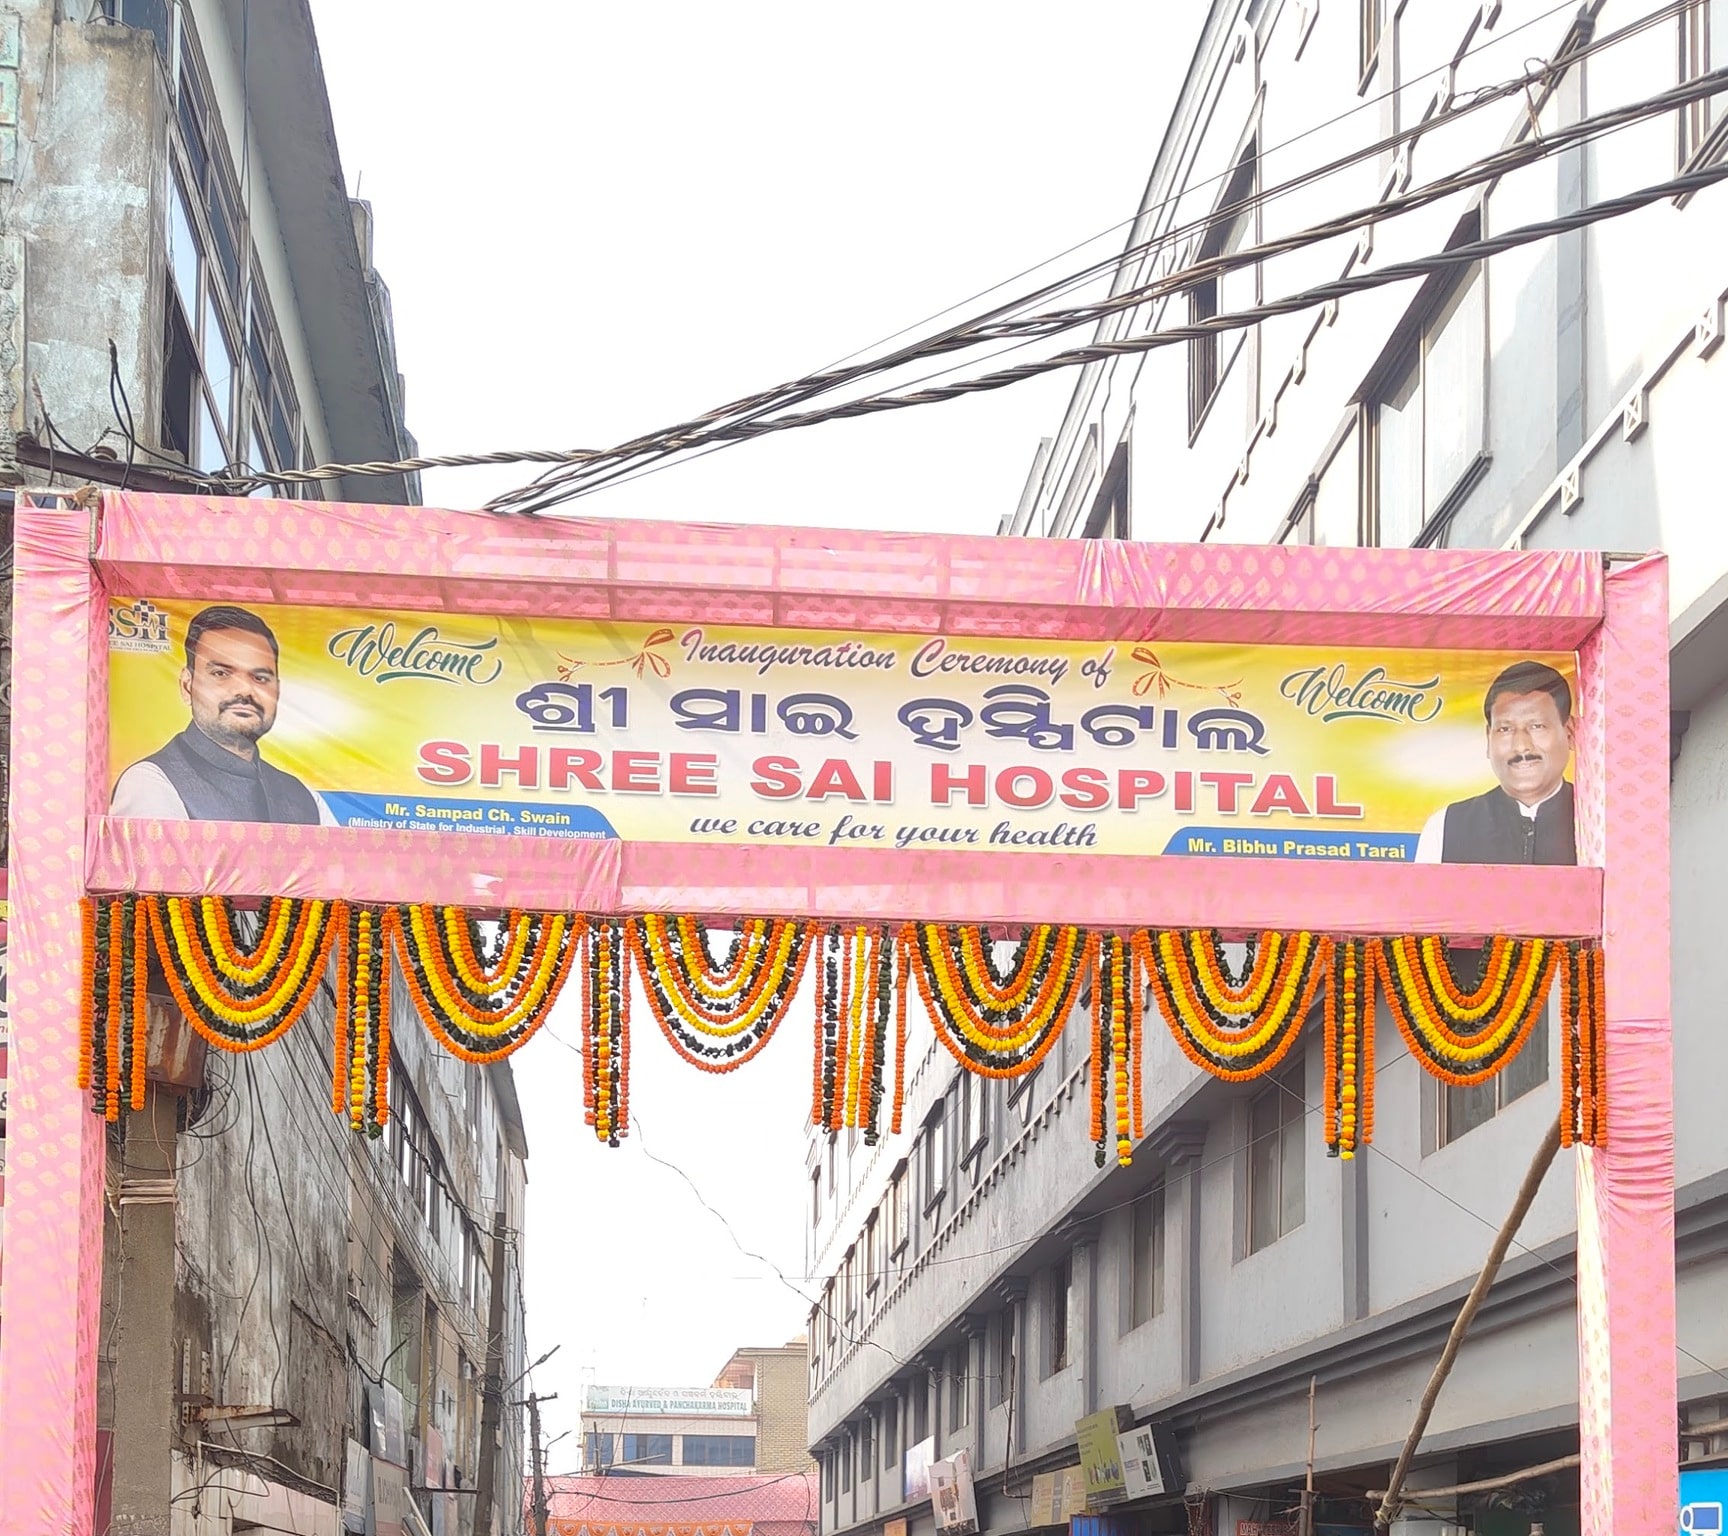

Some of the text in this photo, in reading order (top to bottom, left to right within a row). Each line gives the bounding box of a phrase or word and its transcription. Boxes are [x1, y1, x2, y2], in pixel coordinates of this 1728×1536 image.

[329, 622, 502, 685] Welcome
[680, 629, 1114, 688] Inauguration Ceremony of
[515, 682, 629, 733] ଶ୍ରୀ
[670, 687, 860, 740] ସାଇ
[1280, 663, 1443, 723] Welcome
[416, 740, 1363, 818] SHREE SAI HOSPITAL
[385, 803, 571, 825] Mr. Sampad Ch. Swain
[395, 819, 408, 829] of
[409, 820, 437, 831] State
[438, 822, 455, 832] for
[456, 823, 506, 835] Industrial
[513, 826, 536, 836] Skill
[539, 827, 606, 840] Development
[690, 814, 1098, 848] we care for your health
[1188, 838, 1406, 859] Mr. Bibhu Prasad Tarai
